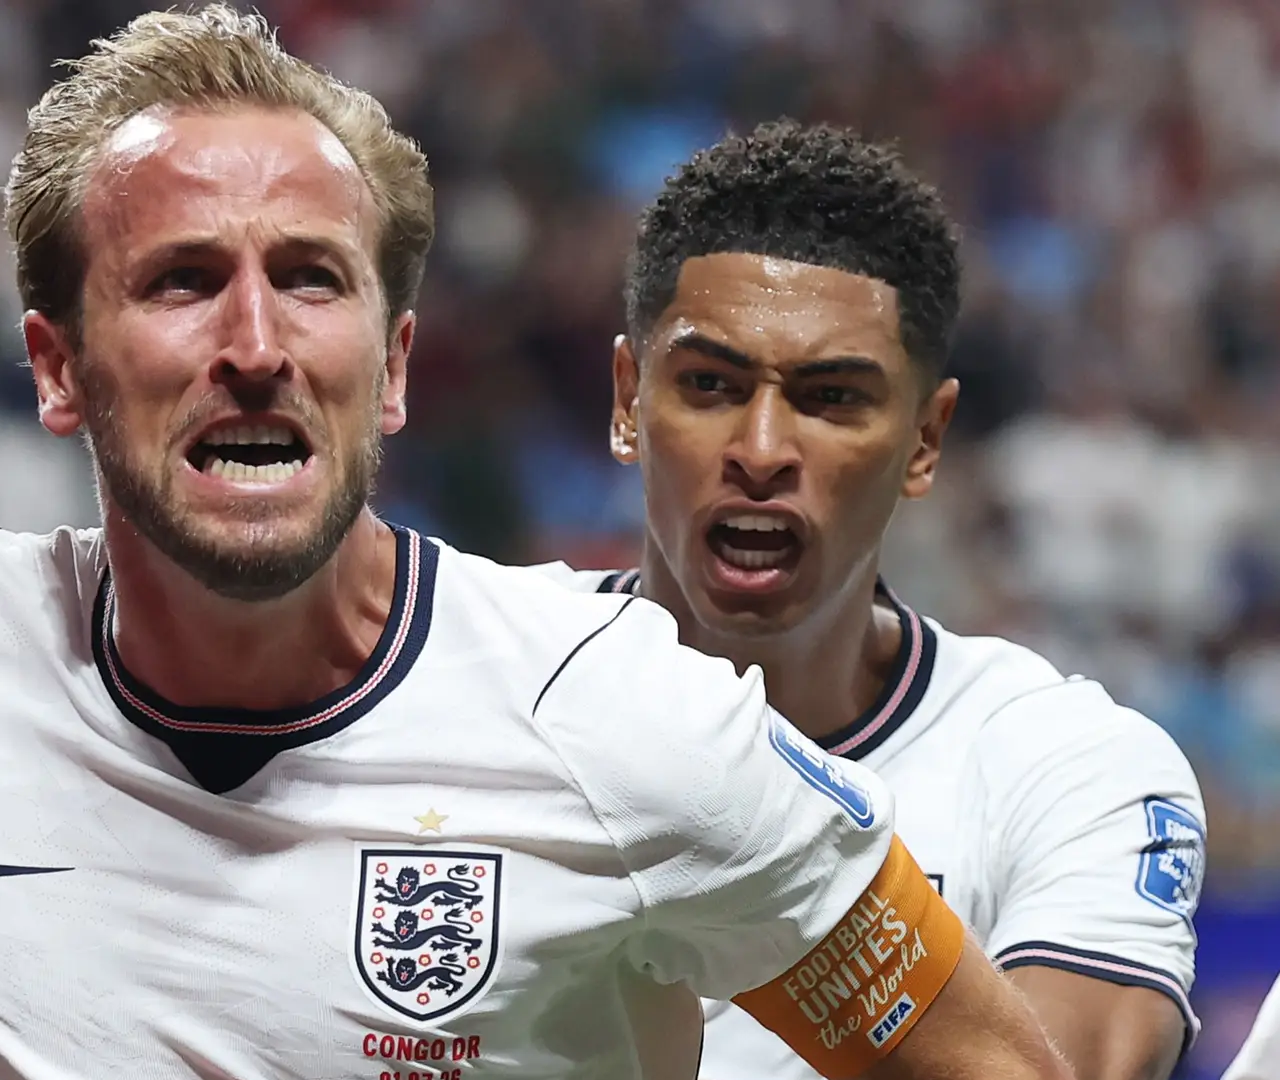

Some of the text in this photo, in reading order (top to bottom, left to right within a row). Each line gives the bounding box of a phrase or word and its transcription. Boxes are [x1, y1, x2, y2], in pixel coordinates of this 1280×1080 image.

[782, 889, 889, 1000] FOOTBALL
[798, 907, 907, 1024] UNITES
[815, 927, 927, 1050] the World
[363, 1033, 480, 1061] CONGO DR
[872, 1000, 912, 1043] FIFA
